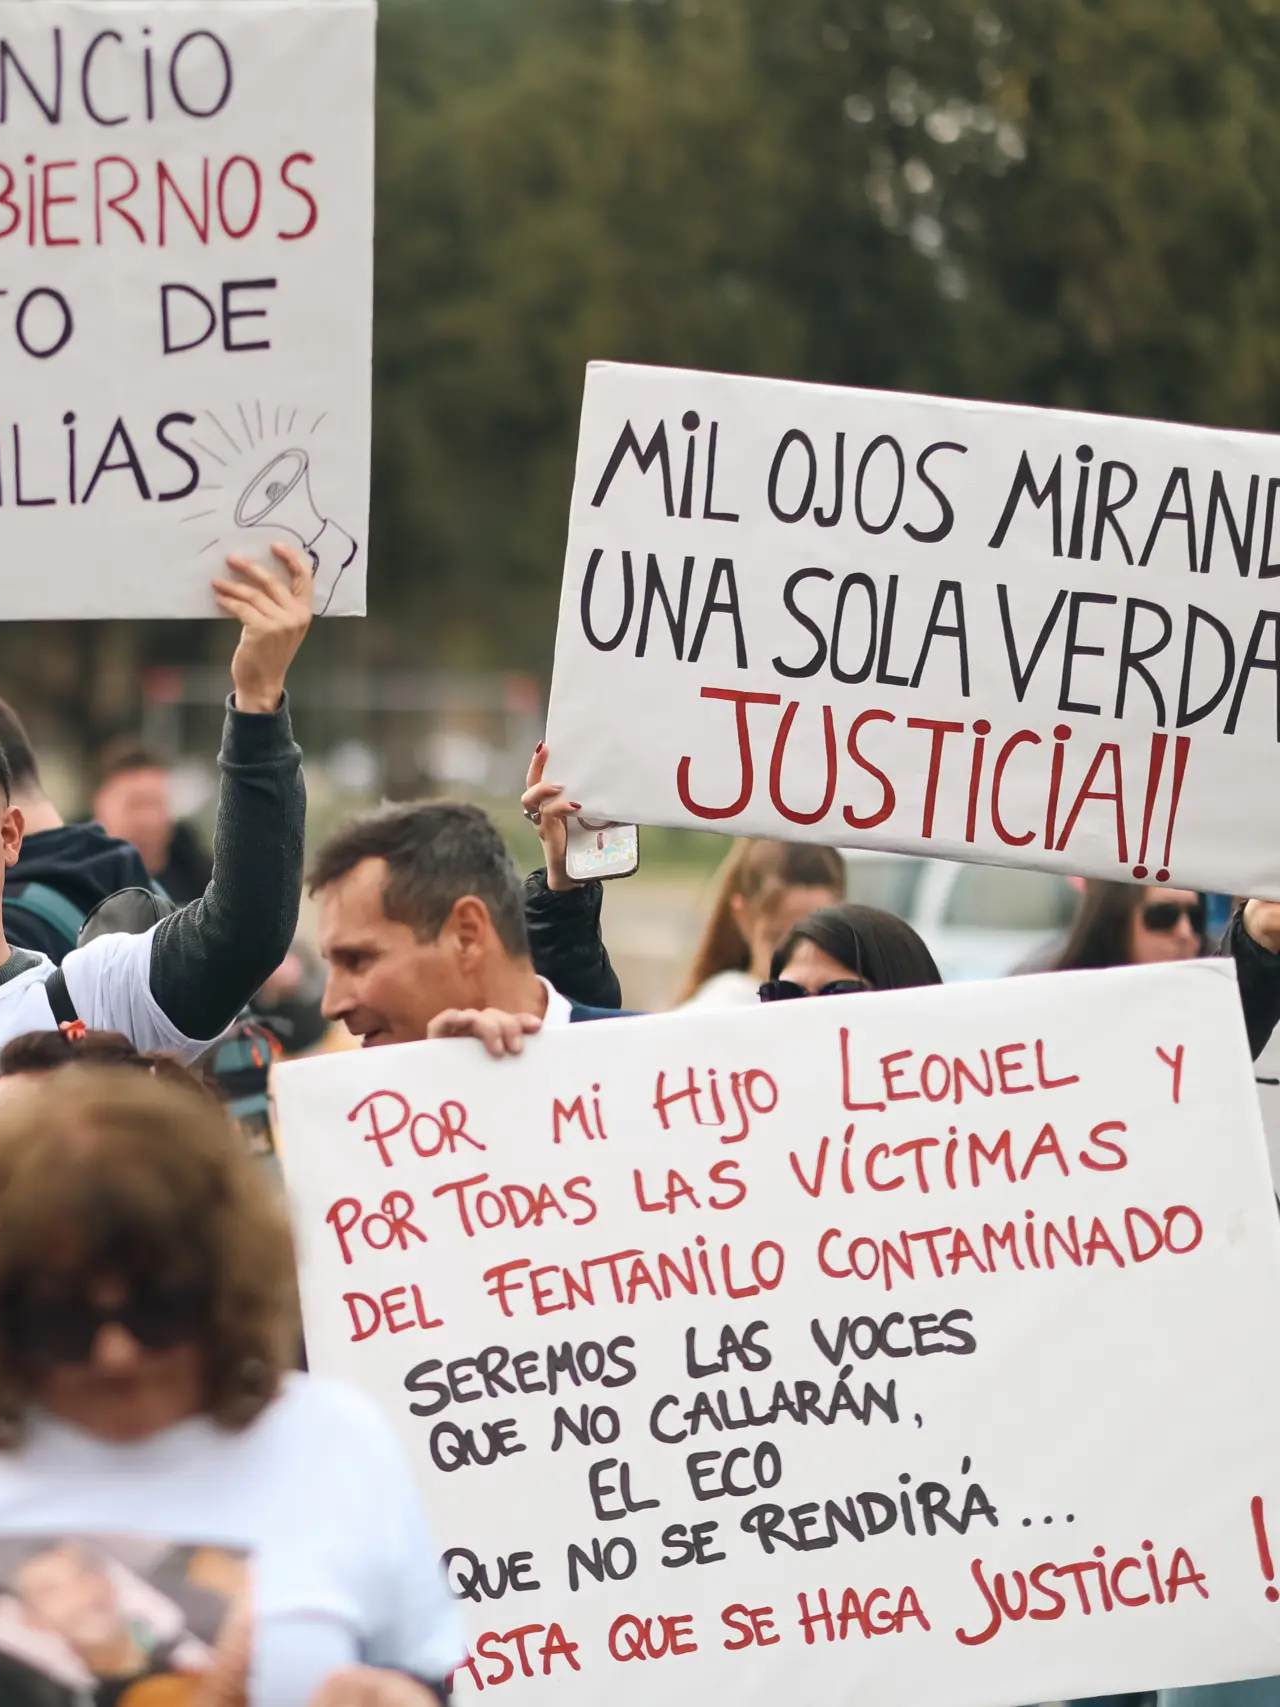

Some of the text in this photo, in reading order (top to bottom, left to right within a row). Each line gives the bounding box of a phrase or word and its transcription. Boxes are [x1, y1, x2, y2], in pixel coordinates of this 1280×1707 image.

[161, 278, 277, 355] DE
[768, 428, 968, 543] OJOS
[580, 548, 1280, 743] UNA SOLA VERDA
[348, 1089, 487, 1168] POR
[838, 1027, 1080, 1114] LEONEL
[1155, 1043, 1185, 1104] Y
[325, 1190, 428, 1265] POR
[433, 1173, 600, 1239] TODAS
[633, 1158, 747, 1215] LAS
[341, 1285, 444, 1343] DEL
[404, 1308, 977, 1418] SEREMOS LAS VOCES
[428, 1366, 924, 1473] QUE NO CALLARÁN,
[588, 1441, 782, 1522] EL ECO
[439, 1545, 542, 1602] QUE
[566, 1535, 638, 1592] NO
[660, 1521, 725, 1570] SE
[608, 1613, 698, 1662] QUE
[721, 1604, 780, 1651] SE
[798, 1584, 931, 1644] HAGA
